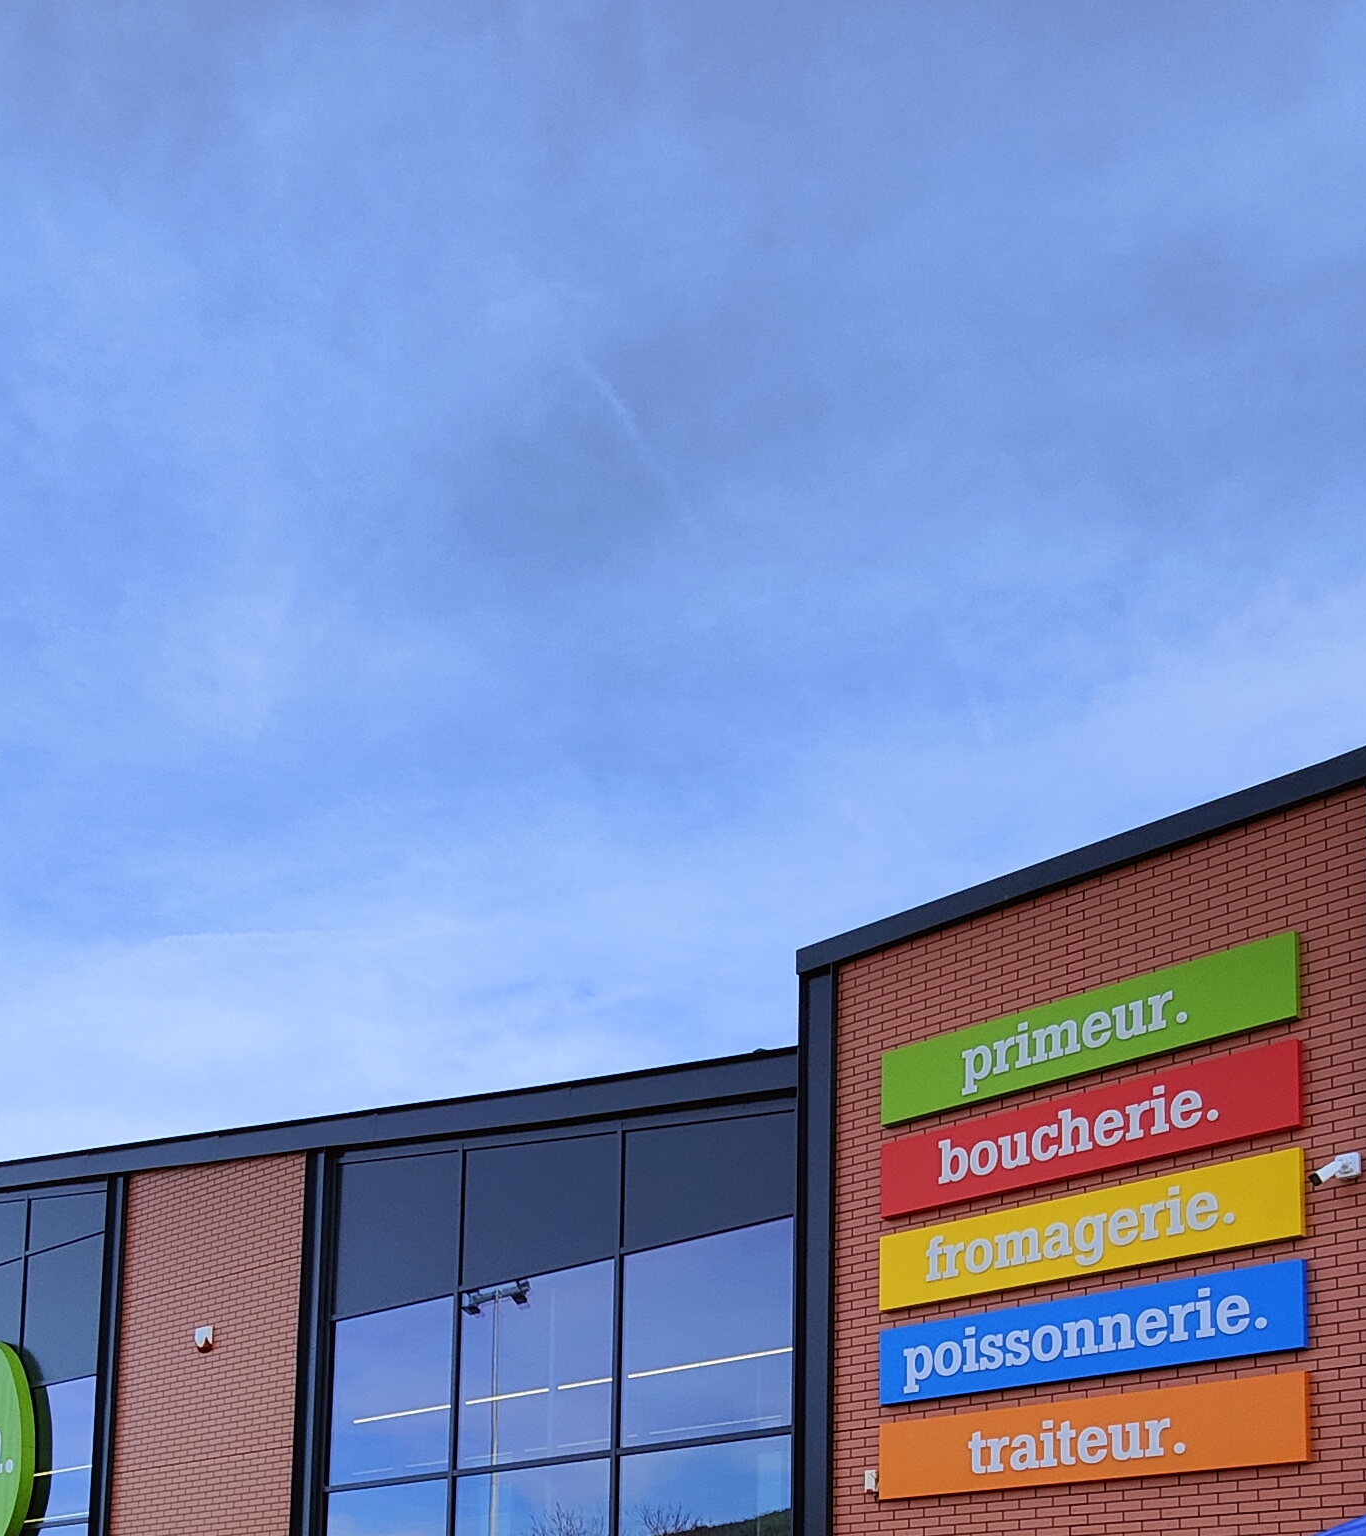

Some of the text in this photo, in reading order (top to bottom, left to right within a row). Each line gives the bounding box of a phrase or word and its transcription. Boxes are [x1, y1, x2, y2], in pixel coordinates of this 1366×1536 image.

[961, 990, 1188, 1096] primeur.
[937, 1085, 1219, 1185] boucherie.
[925, 1186, 1236, 1282] fromagerie.
[903, 1287, 1268, 1394] poissonnerie.
[968, 1417, 1187, 1475] traiteur.
